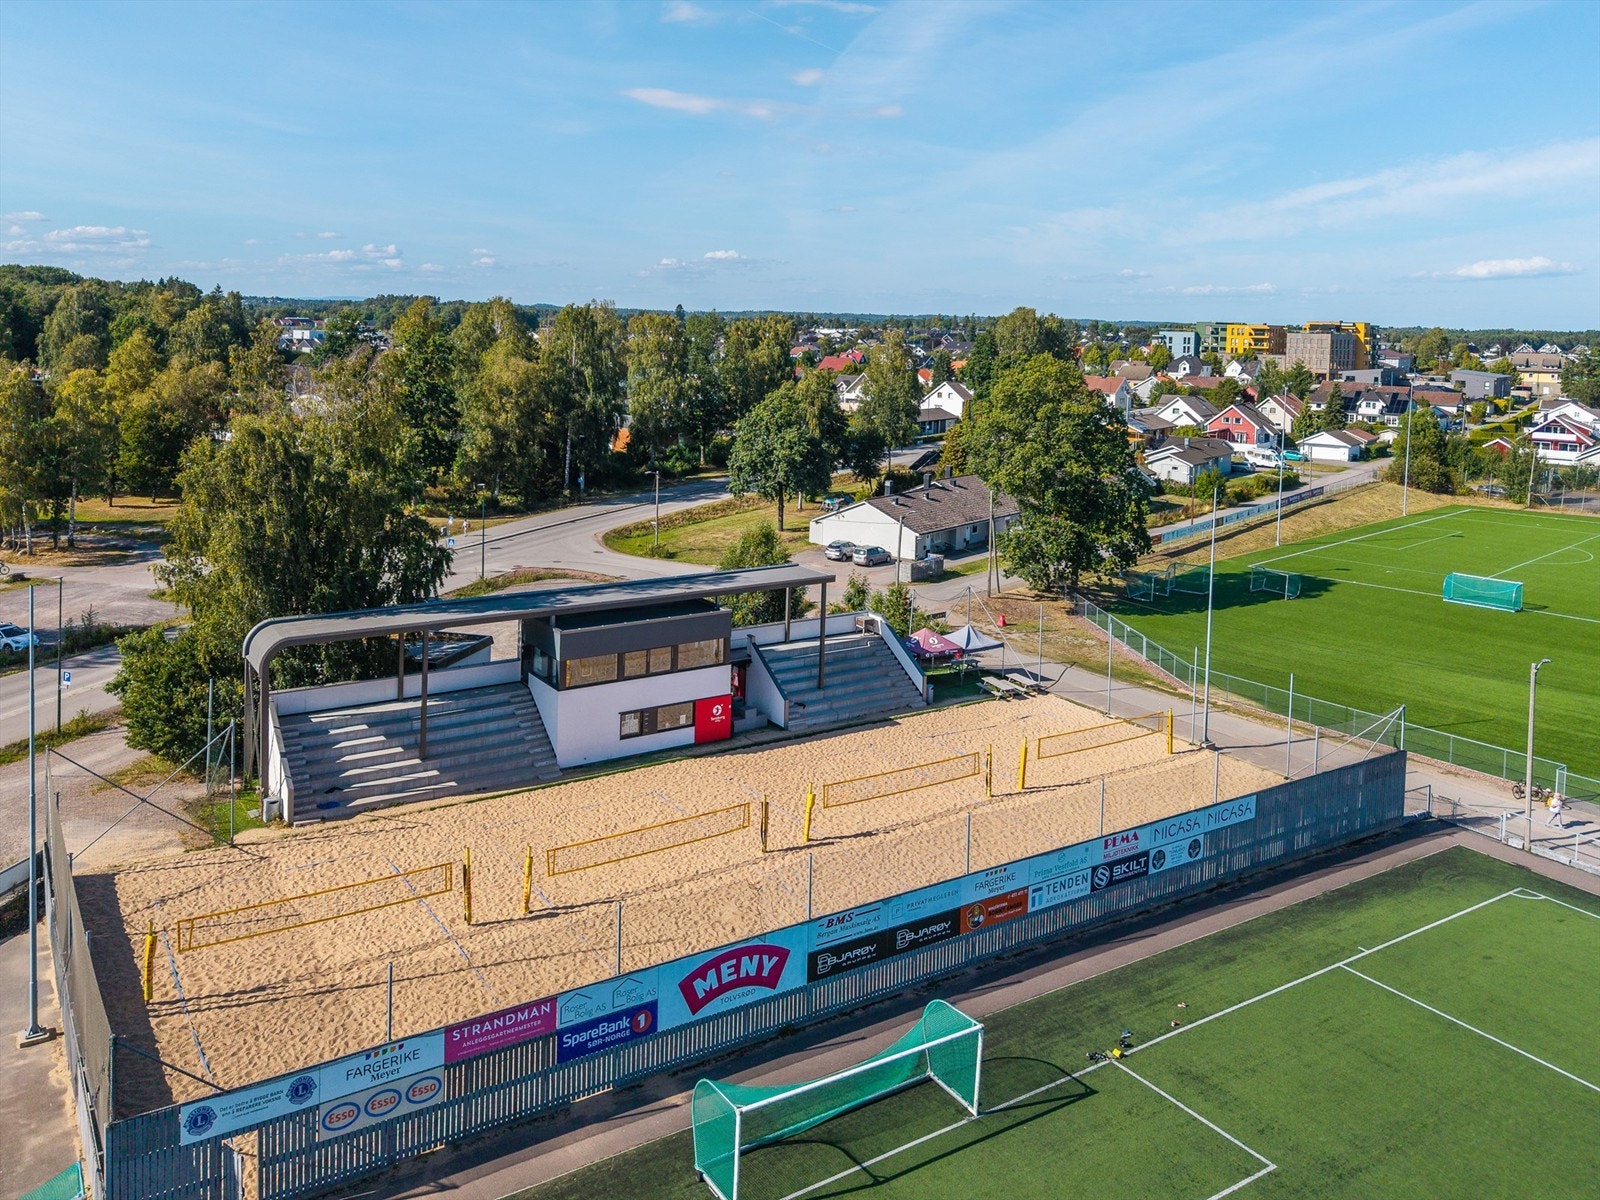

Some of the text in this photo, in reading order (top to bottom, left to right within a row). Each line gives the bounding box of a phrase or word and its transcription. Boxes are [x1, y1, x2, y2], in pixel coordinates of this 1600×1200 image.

[1103, 831, 1139, 850] PEMA
[1079, 856, 1088, 864] AS
[1112, 857, 1147, 877] SKILT
[975, 872, 1016, 892] FARGERIKE
[987, 884, 1006, 894] Meyer
[1046, 872, 1089, 895] TENDEN
[906, 889, 959, 909] PRIVATMEGLEREN
[825, 912, 854, 929] BMS
[692, 954, 780, 999] MENY
[616, 986, 639, 998] Roser
[626, 987, 657, 1004] Bolig AS
[719, 988, 756, 1005] TOLVSRØD
[564, 1001, 587, 1014] Roser
[574, 1002, 607, 1019] Bolig AS
[452, 1003, 551, 1041] STRANDMAN
[563, 1016, 631, 1047] SpareBank
[637, 1013, 646, 1029] 1
[462, 1019, 542, 1048] ANLEGGSGARTNERMESTER
[587, 1029, 631, 1049] SØR-NORGE
[346, 1048, 421, 1081] FARGERIKE
[370, 1067, 402, 1083] Meyer
[270, 1089, 284, 1097] BARN
